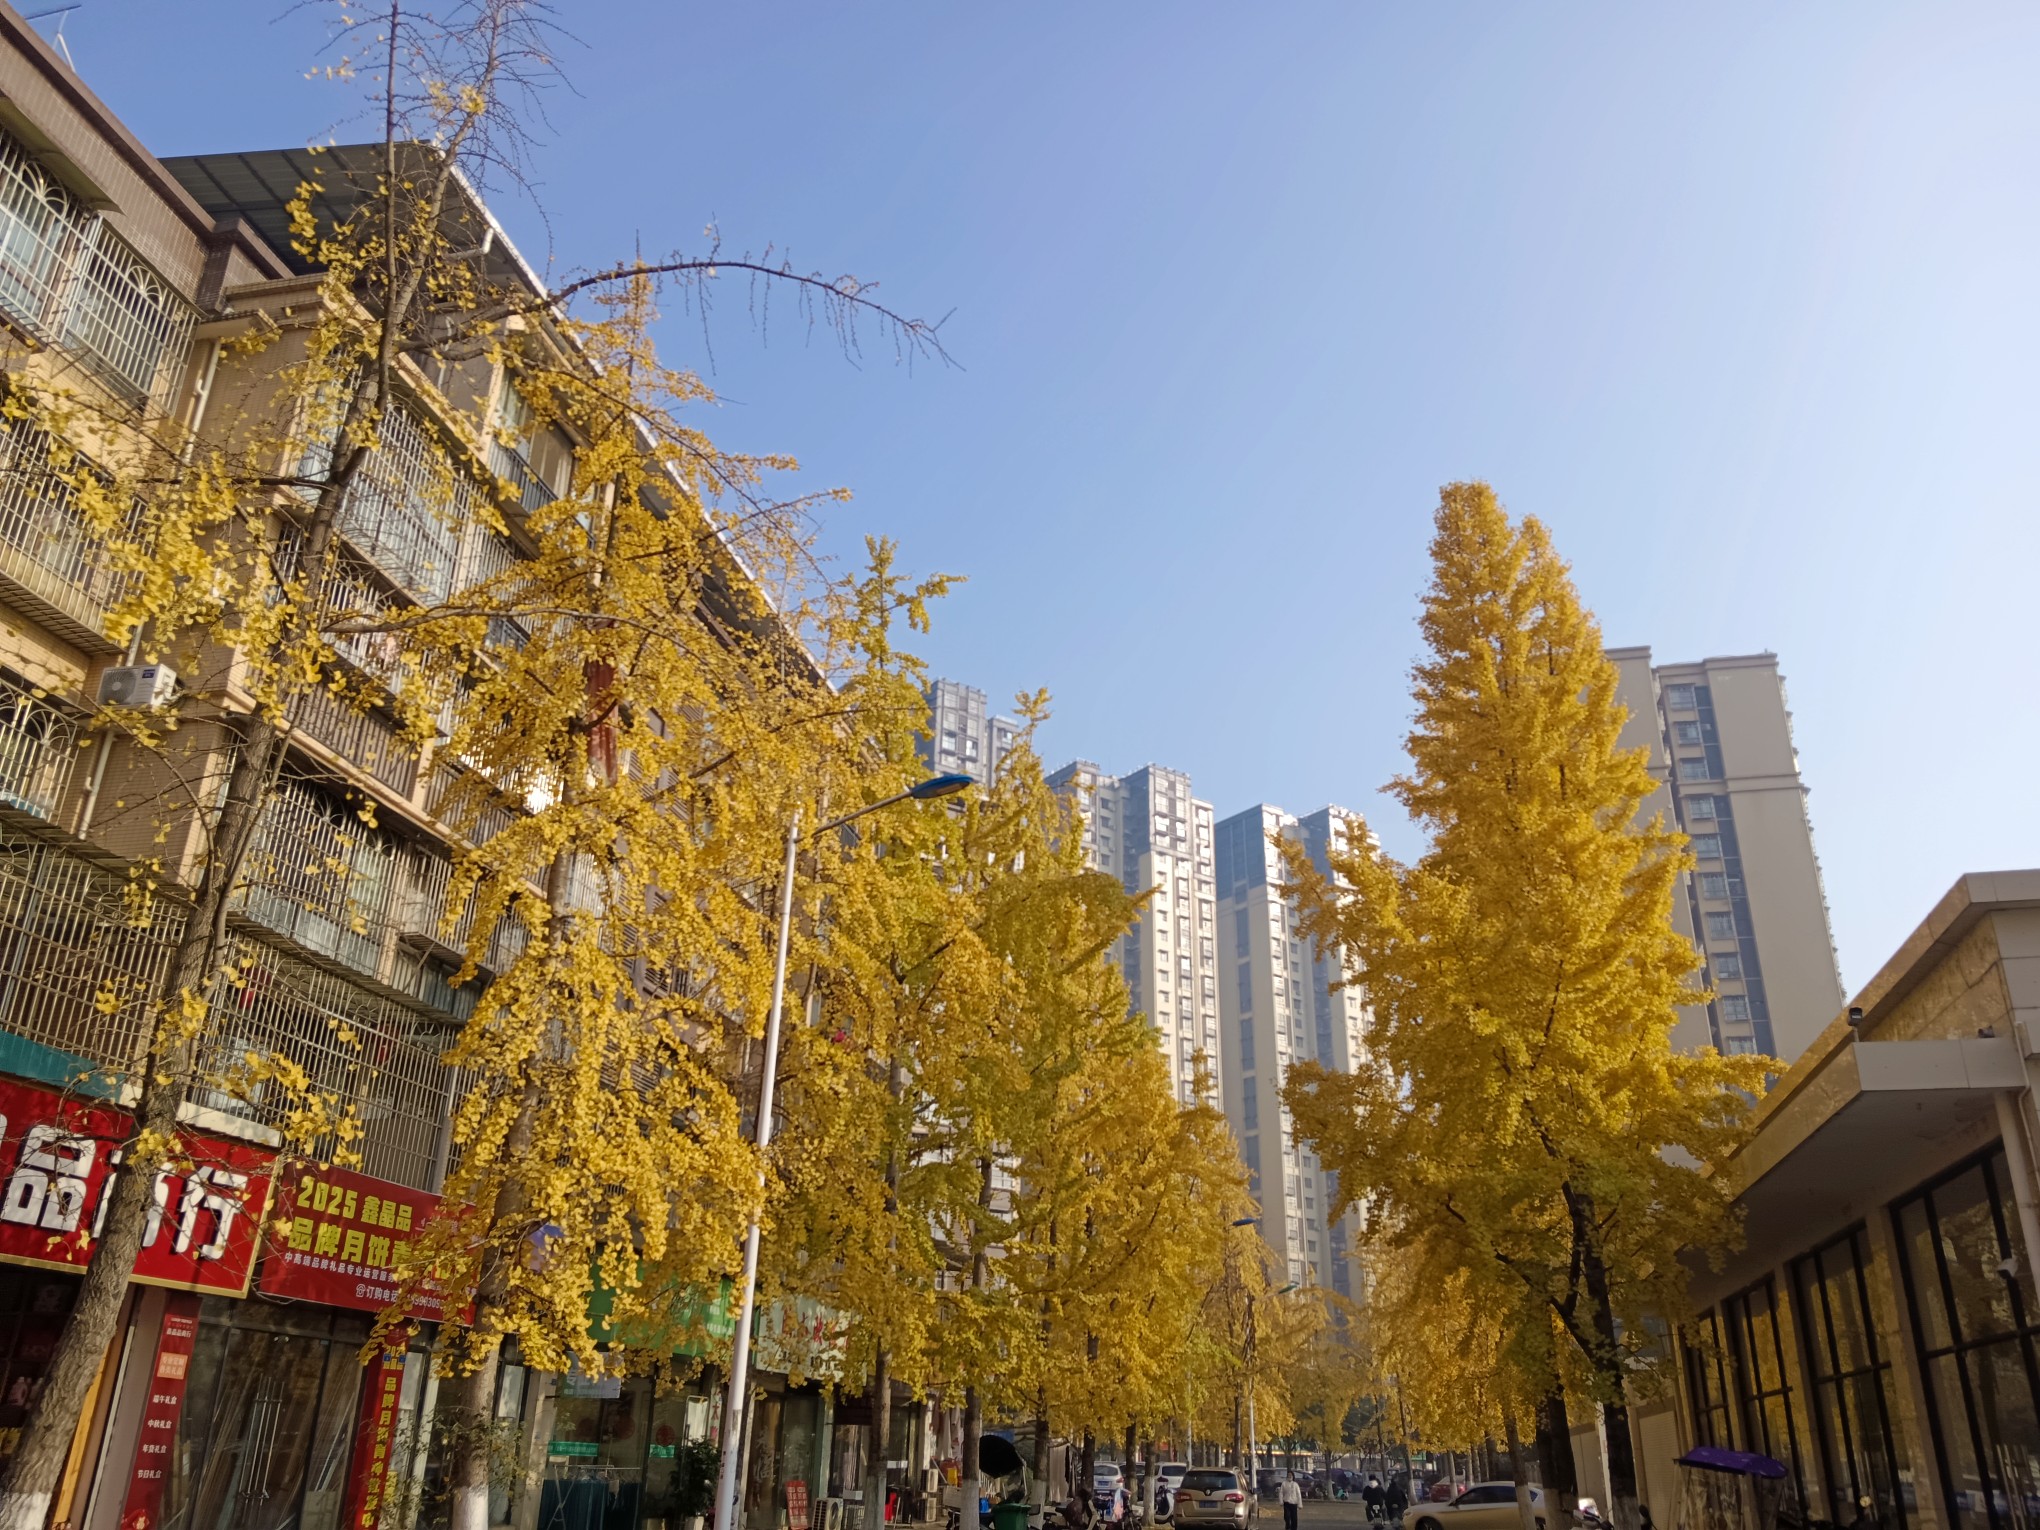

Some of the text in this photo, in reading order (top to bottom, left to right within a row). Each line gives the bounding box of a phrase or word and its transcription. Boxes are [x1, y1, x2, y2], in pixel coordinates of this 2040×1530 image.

[297, 1175, 413, 1232] 2025 鑫晶品
[152, 1394, 177, 1404] 端午礼盒
[147, 1419, 172, 1429] 中秋礼盒
[142, 1444, 167, 1454] 年货礼盒
[137, 1470, 162, 1479] 节日礼盒
